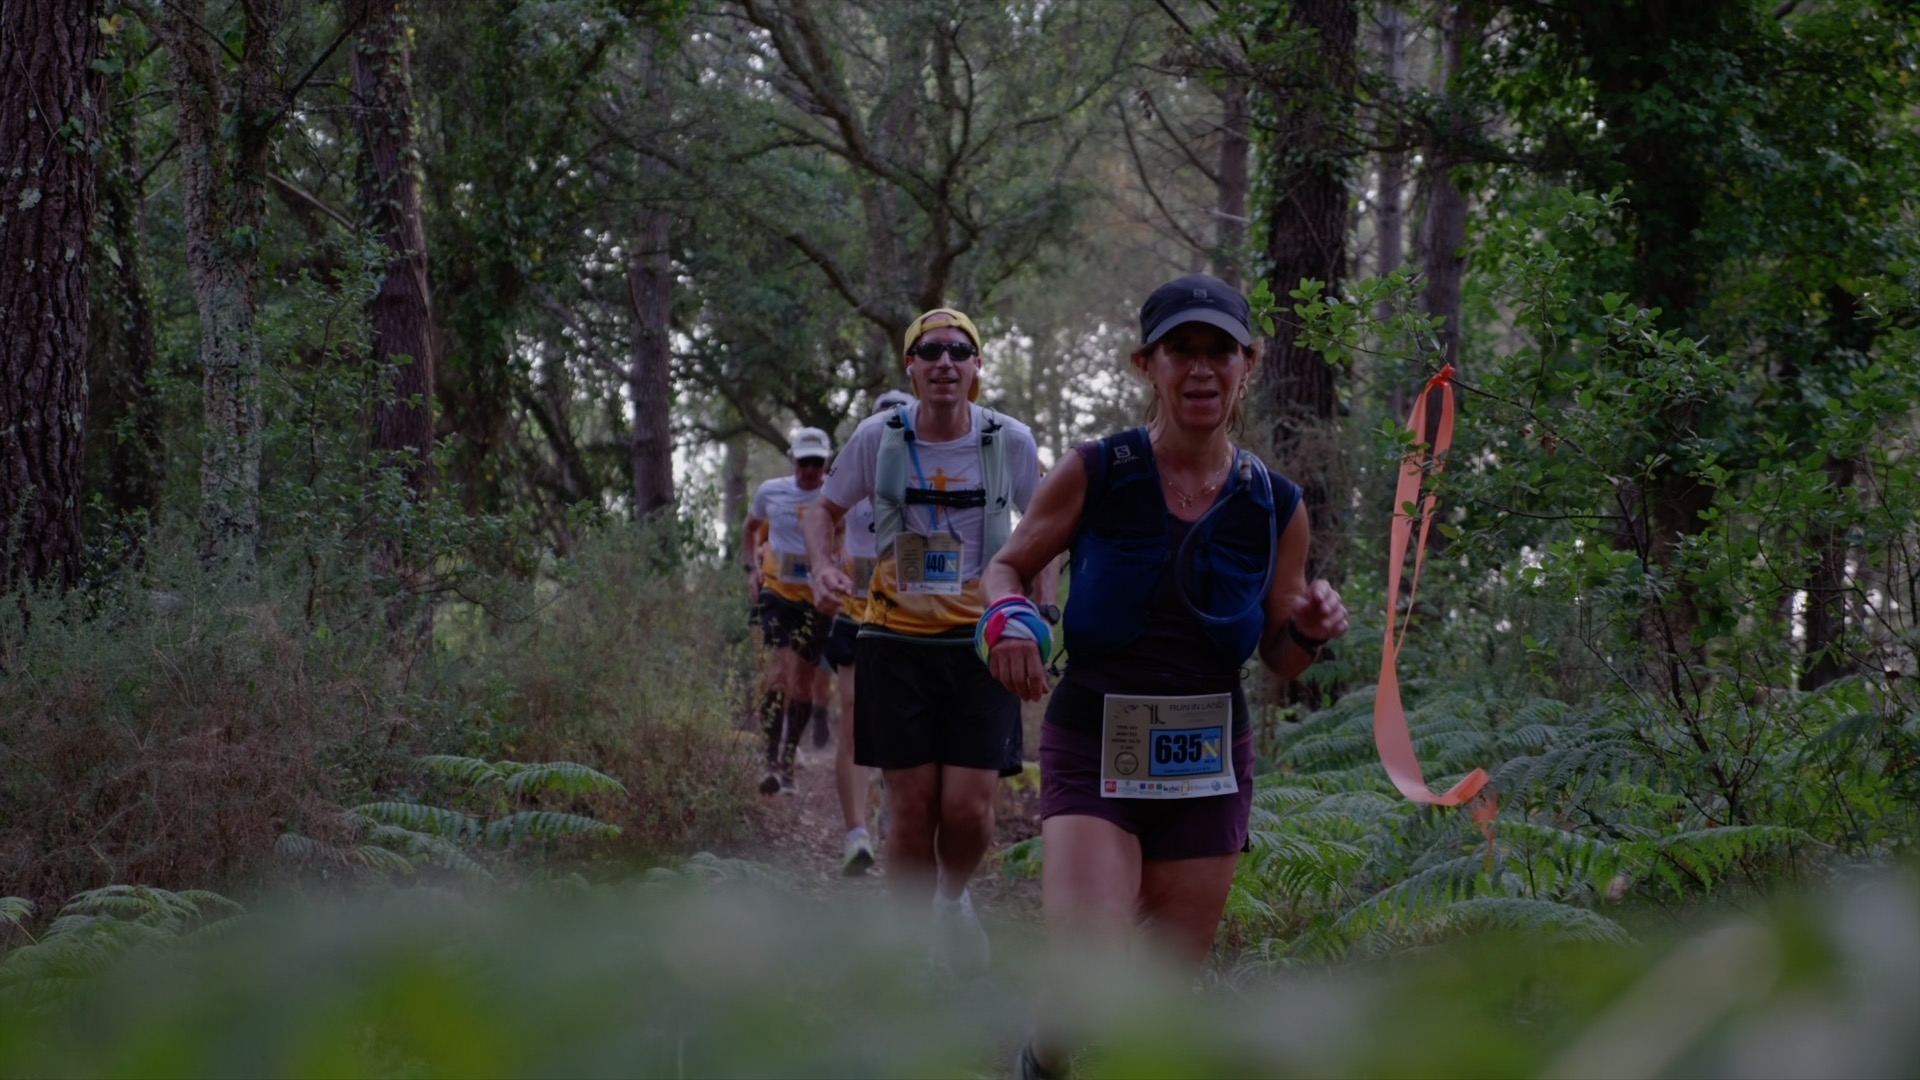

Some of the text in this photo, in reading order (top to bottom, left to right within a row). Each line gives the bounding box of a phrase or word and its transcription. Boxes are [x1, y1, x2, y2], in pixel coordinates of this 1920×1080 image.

[1169, 704, 1189, 712] RUN
[1201, 701, 1225, 710] LAND
[1155, 733, 1202, 764] 635
